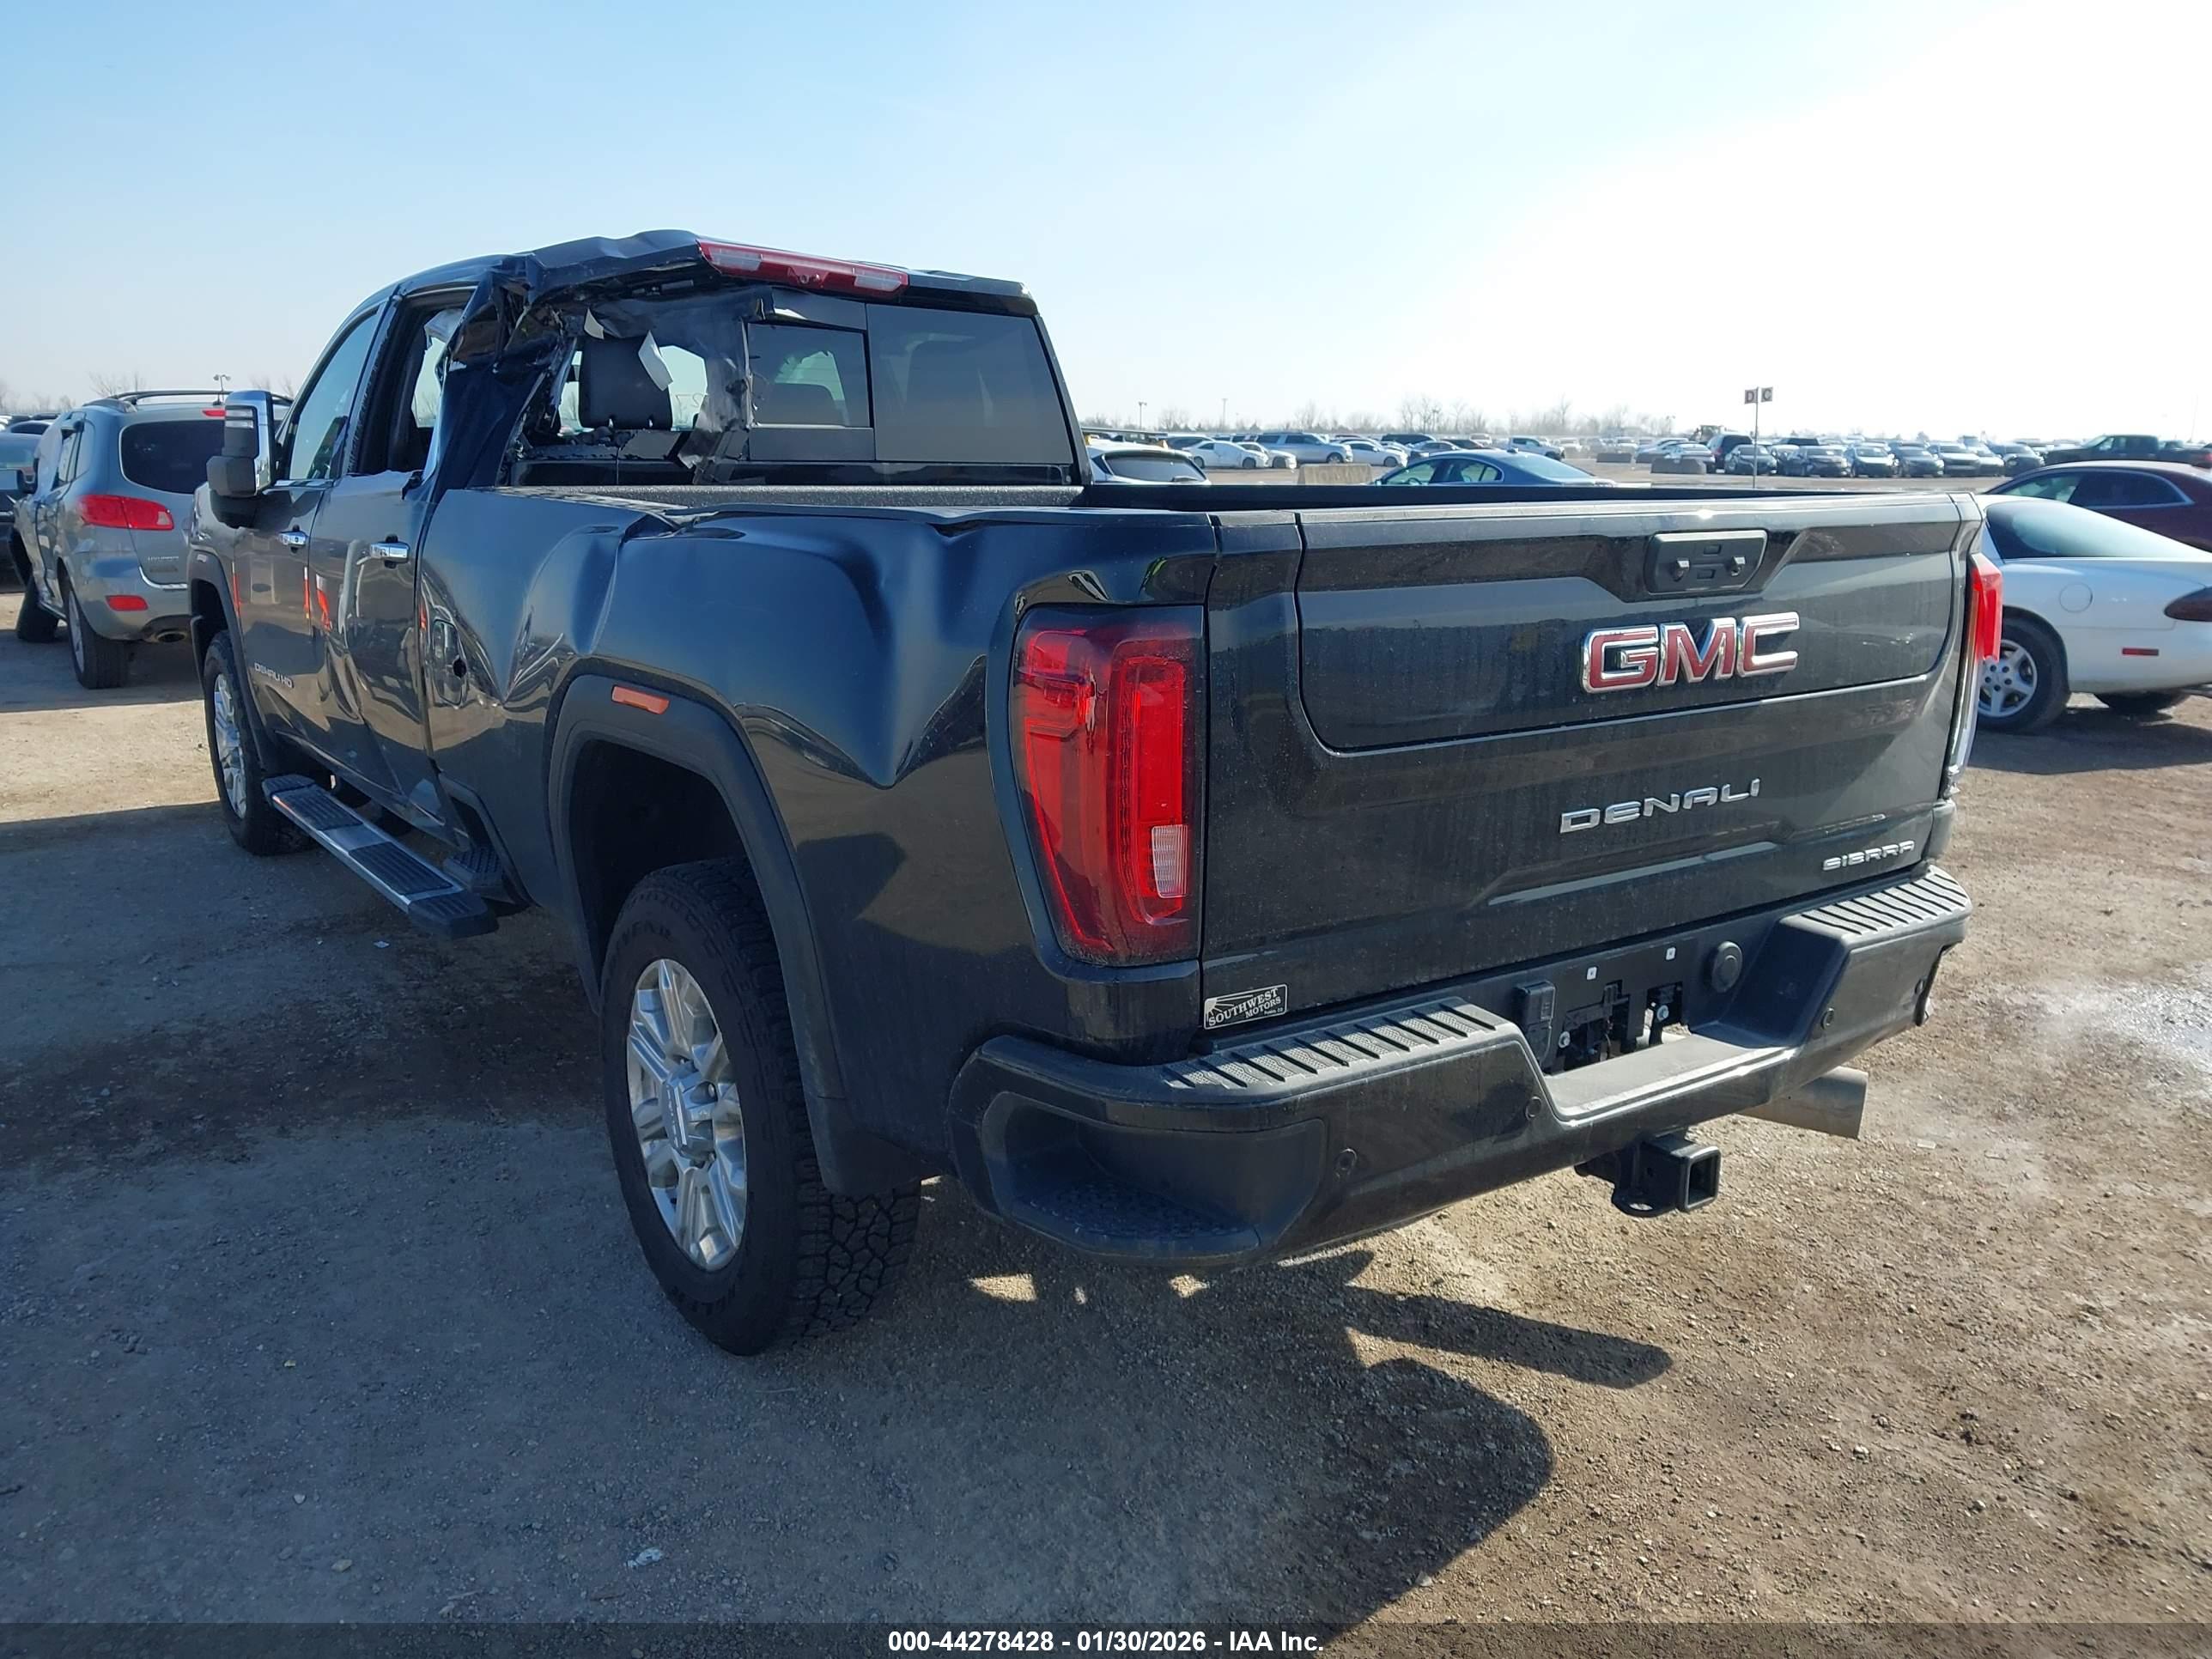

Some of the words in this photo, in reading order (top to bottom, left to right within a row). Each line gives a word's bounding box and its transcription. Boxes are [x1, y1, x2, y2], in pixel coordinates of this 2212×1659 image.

[1746, 391, 1755, 403] D
[1762, 389, 1771, 401] C
[1581, 611, 1800, 694] GMC
[1559, 778, 1760, 834] DENALI
[1822, 840, 1915, 871] SIERRA
[1208, 988, 1279, 1026] SOUTHWEST
[1245, 997, 1281, 1018] MOTORS
